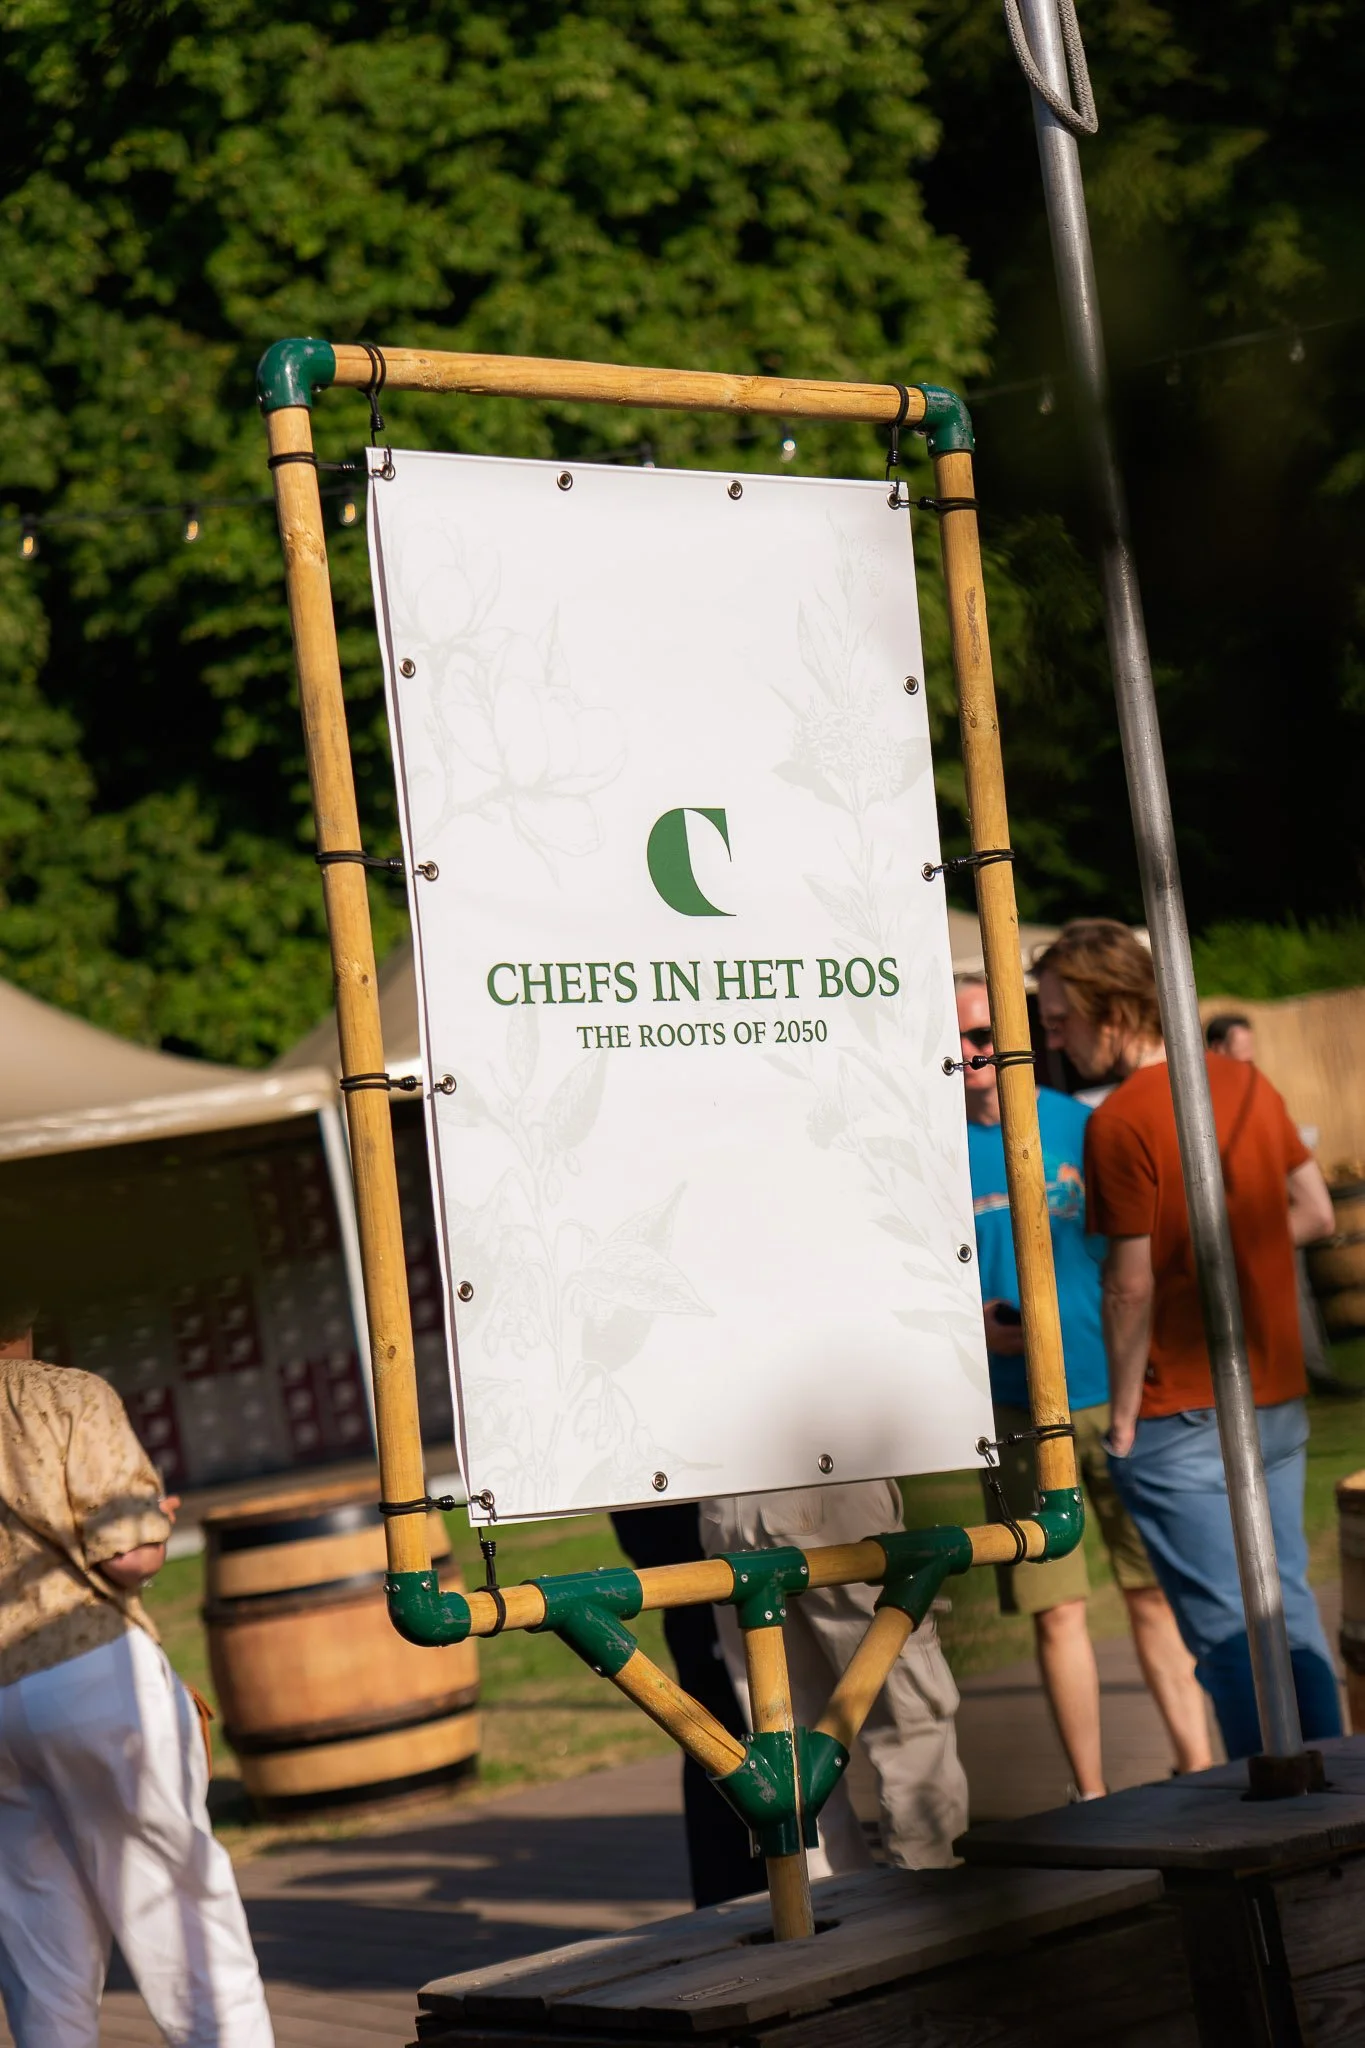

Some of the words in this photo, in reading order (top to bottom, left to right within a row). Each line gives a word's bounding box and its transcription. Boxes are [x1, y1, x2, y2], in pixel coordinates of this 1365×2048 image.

[646, 807, 737, 917] C
[487, 962, 638, 1005] CHEFS
[650, 961, 700, 1002] IN
[714, 960, 804, 1001] HET
[815, 957, 901, 998] BOS
[576, 1025, 631, 1049] THE
[639, 1023, 726, 1047] ROOTS
[733, 1021, 766, 1045] OF
[774, 1019, 828, 1044] 2050
